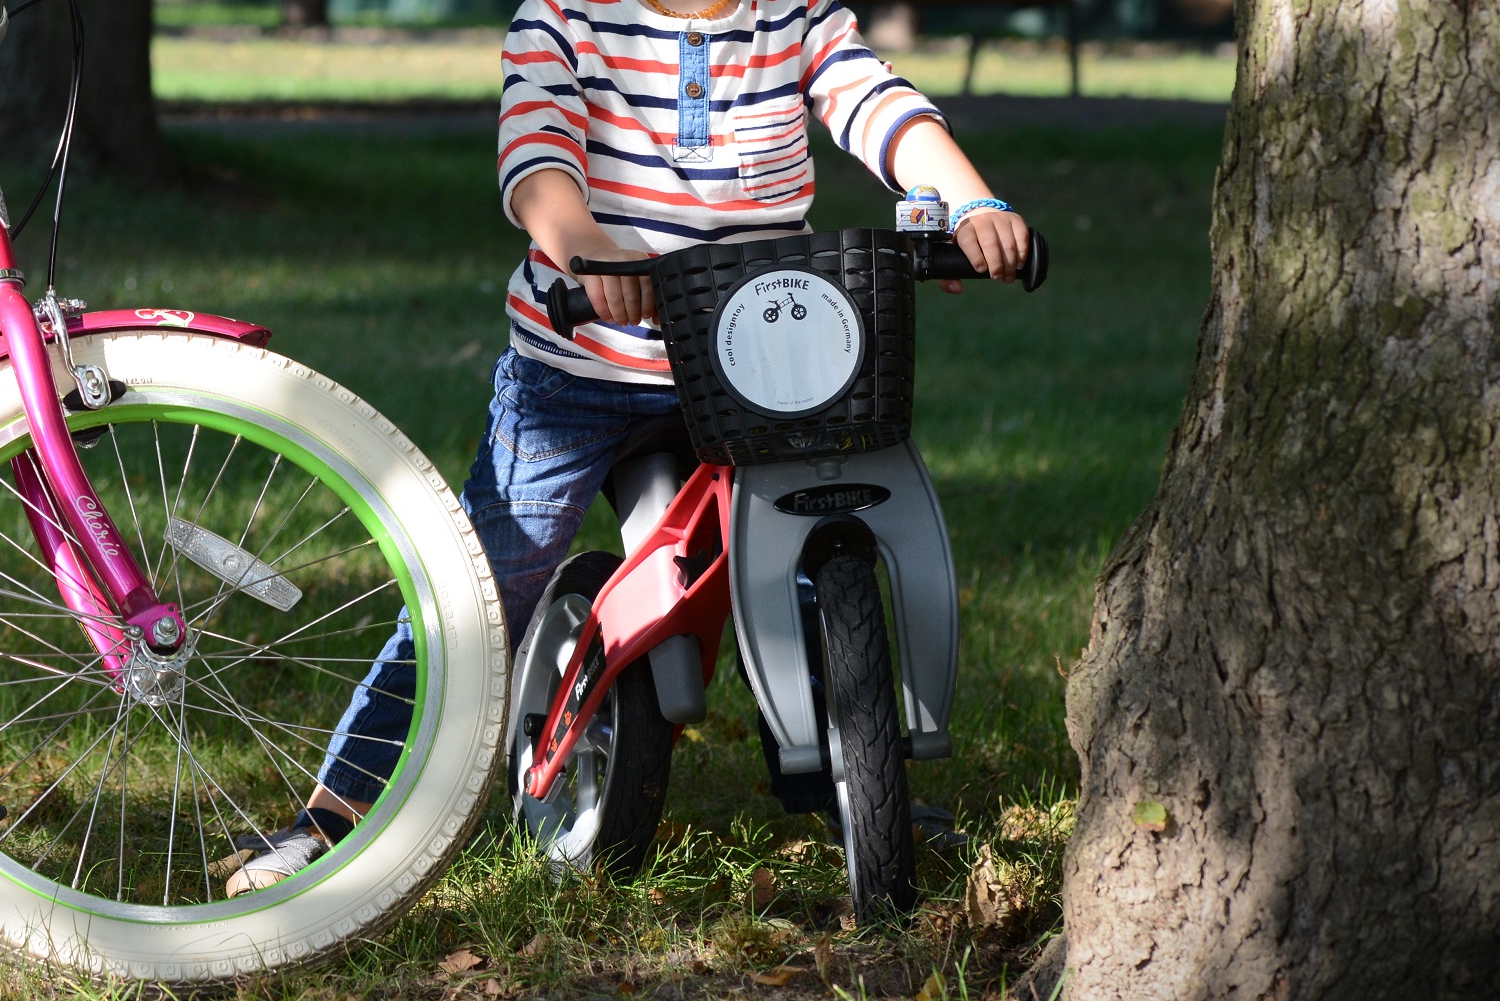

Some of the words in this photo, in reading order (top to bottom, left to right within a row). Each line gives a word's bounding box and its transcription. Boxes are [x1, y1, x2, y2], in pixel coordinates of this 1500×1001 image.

[754, 278, 810, 296] FirstBIKE
[821, 293, 839, 311] made
[837, 310, 844, 319] in
[841, 318, 852, 354] Germany
[725, 348, 736, 366] cool
[793, 489, 872, 512] FirstBIKE
[76, 495, 120, 562] Chérie
